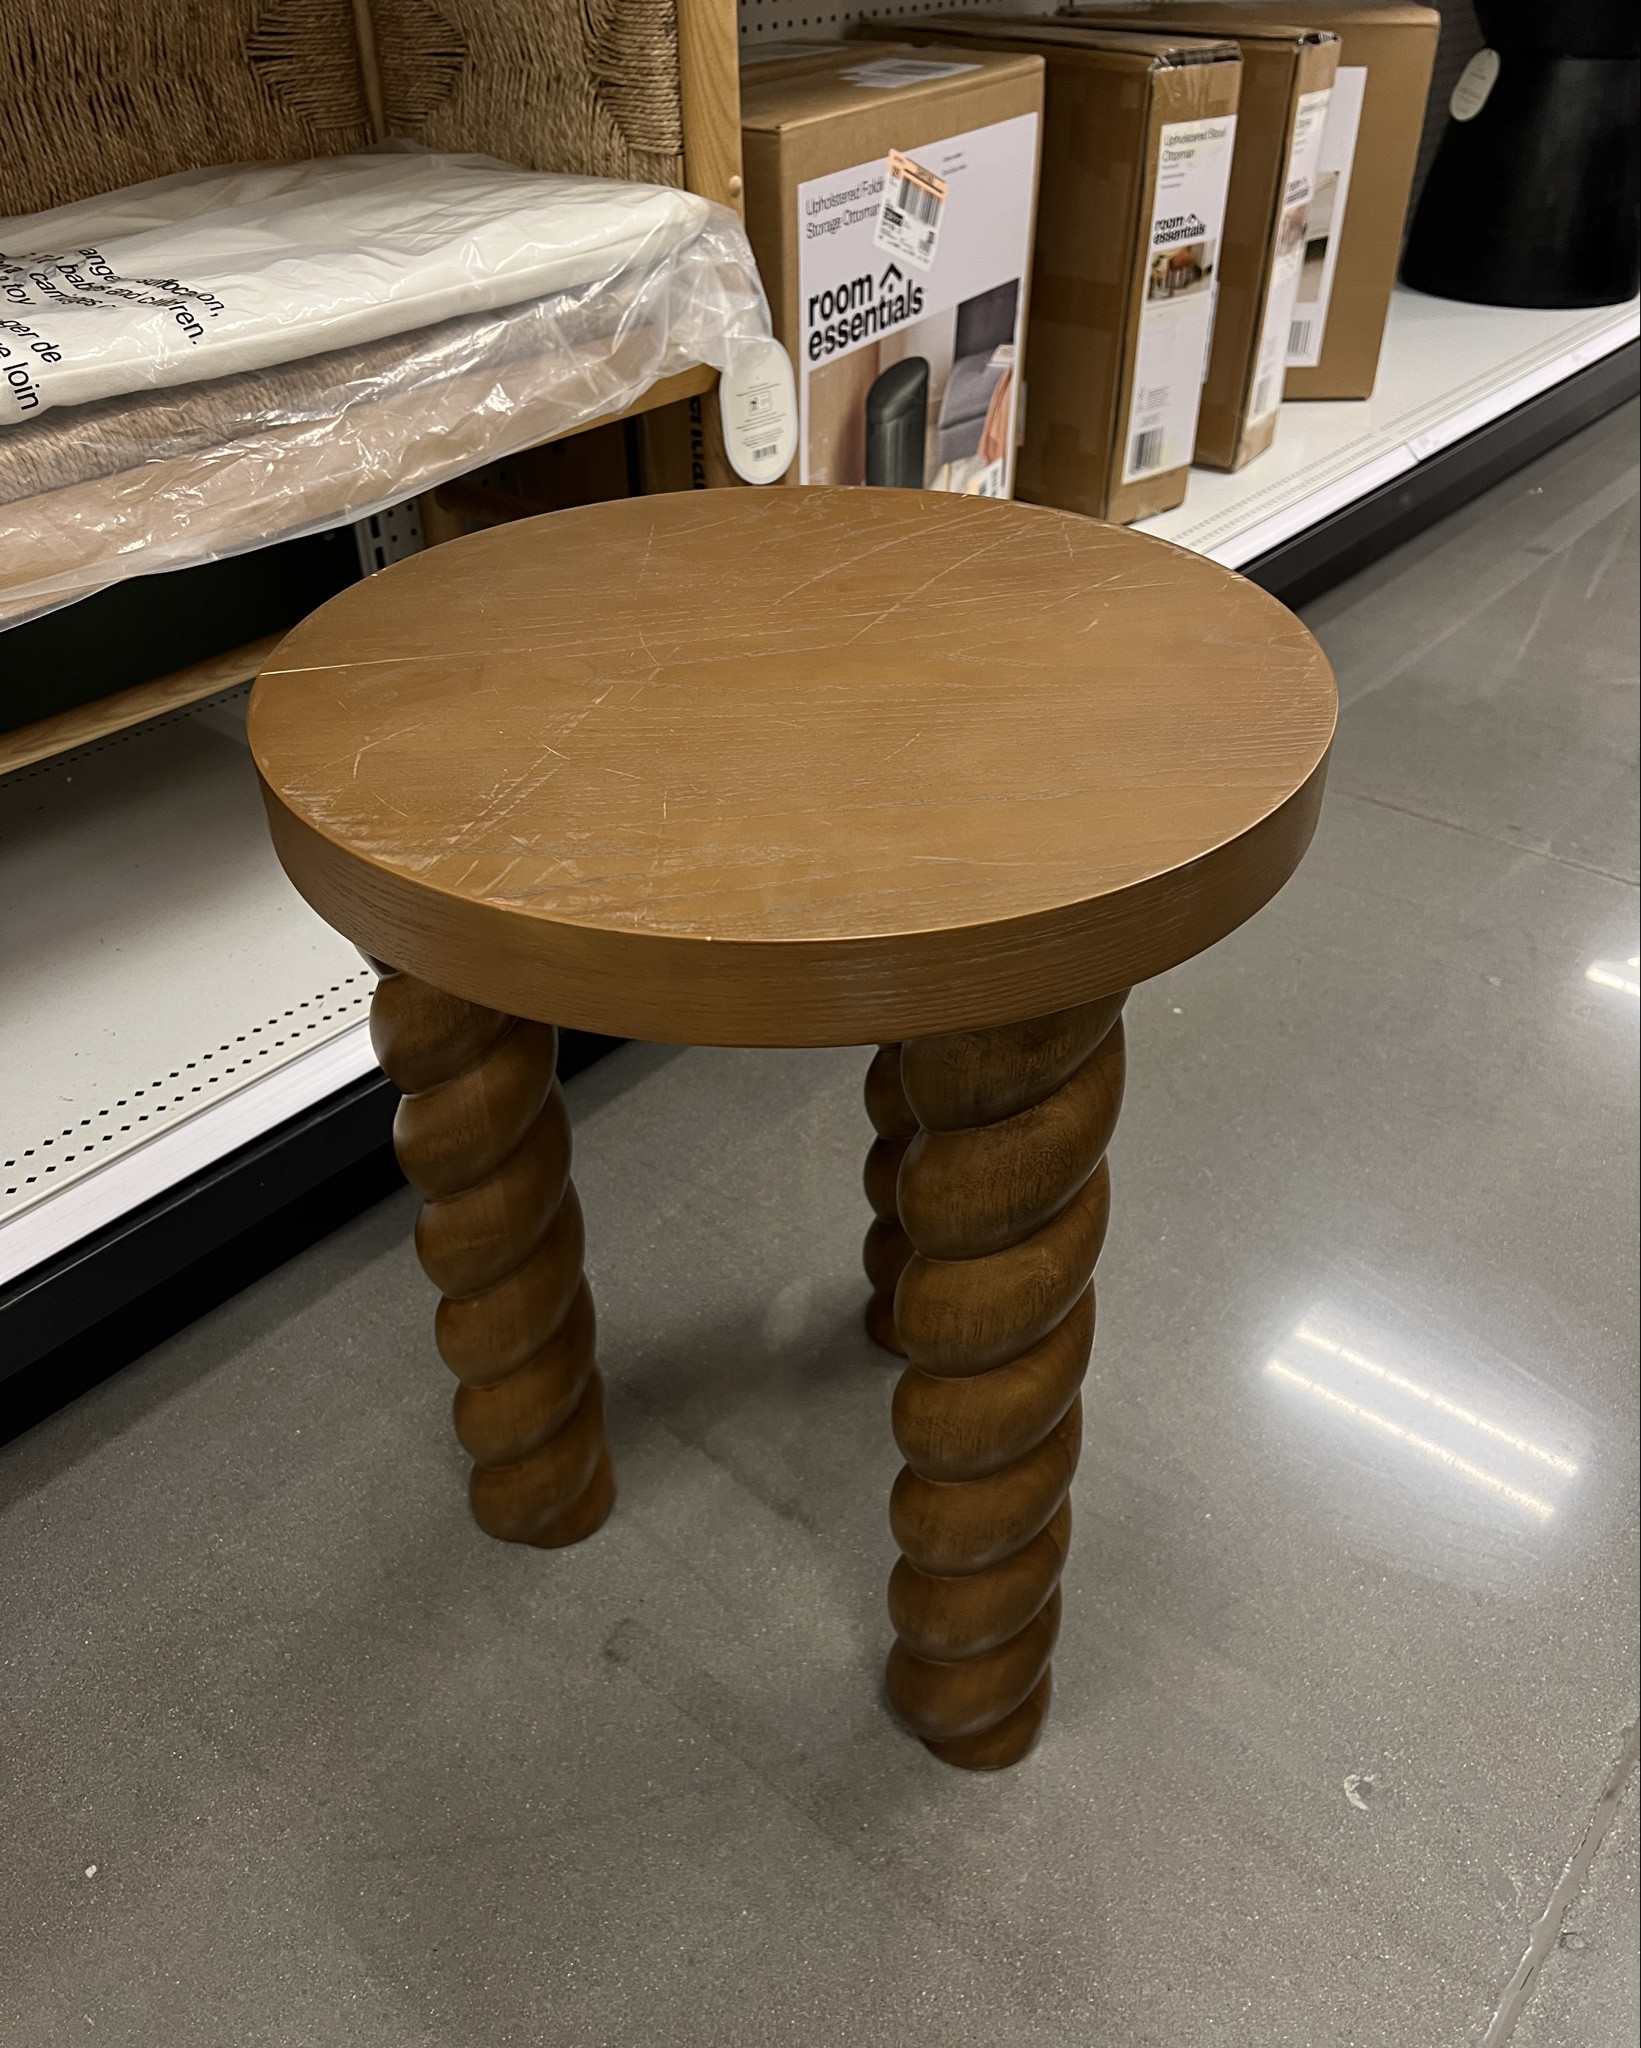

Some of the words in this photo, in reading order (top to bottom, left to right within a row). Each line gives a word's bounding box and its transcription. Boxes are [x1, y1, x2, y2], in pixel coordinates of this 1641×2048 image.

[2, 283, 36, 305] toy
[808, 273, 873, 327] room
[808, 279, 924, 361] essentials
[30, 341, 62, 363] de
[3, 361, 40, 411] loin
